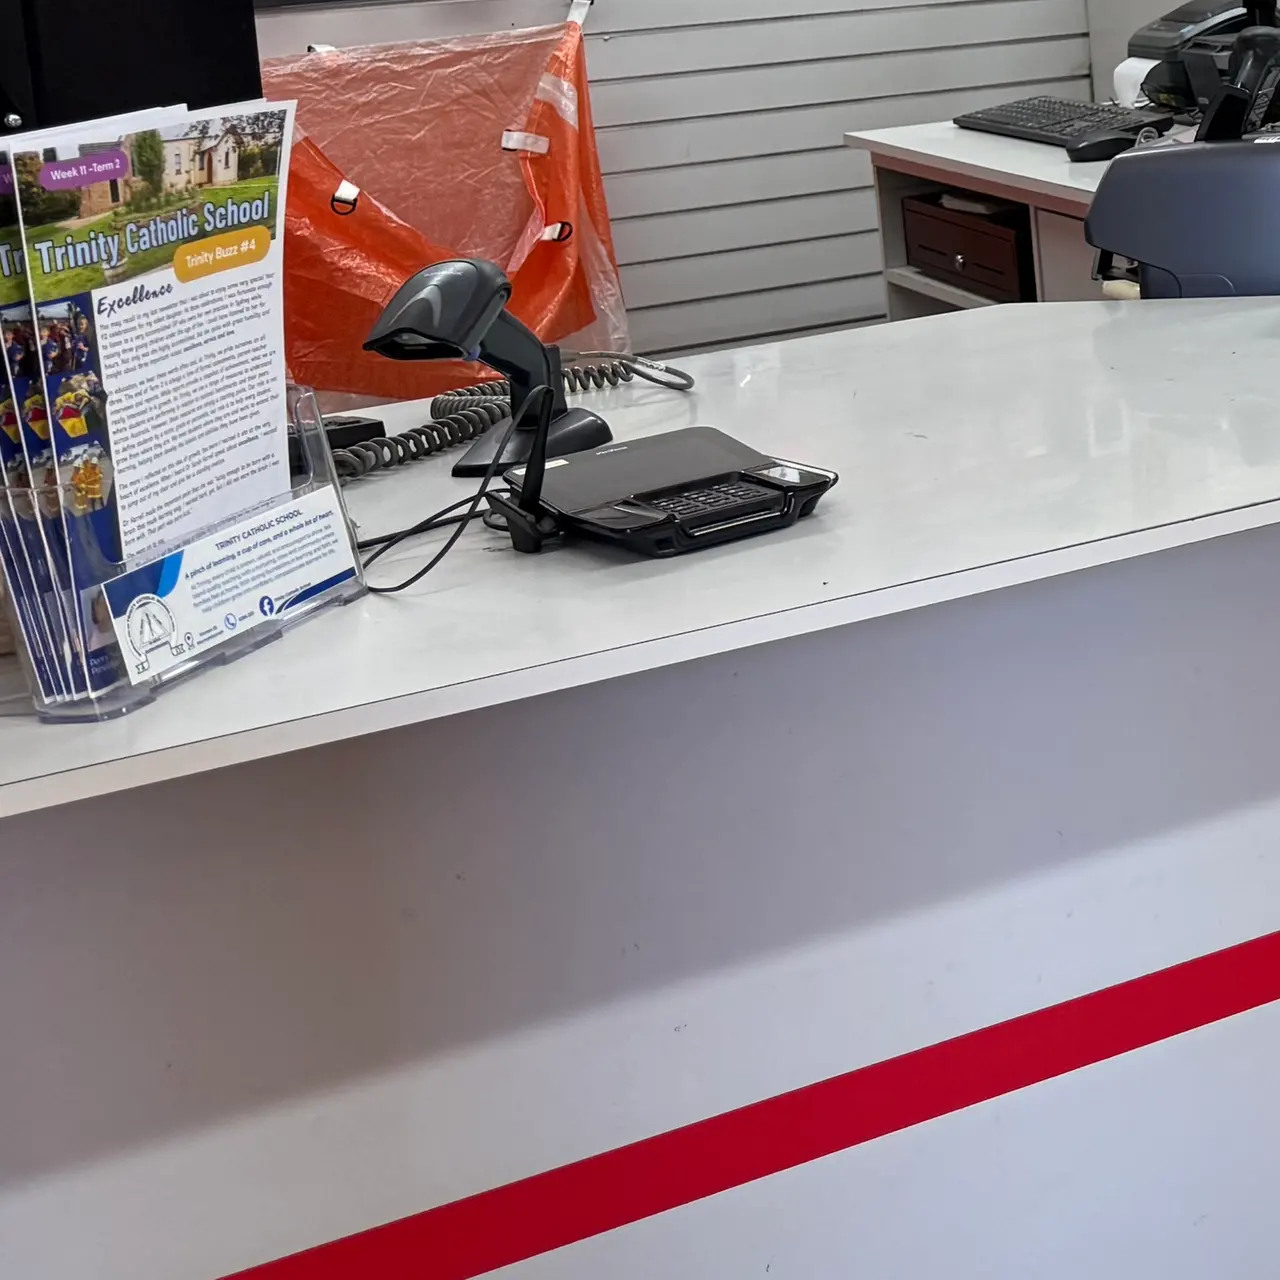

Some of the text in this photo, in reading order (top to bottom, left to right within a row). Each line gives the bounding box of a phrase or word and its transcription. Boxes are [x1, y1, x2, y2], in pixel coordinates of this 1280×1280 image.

[50, 166, 78, 181] Week
[79, 164, 87, 175] 11
[113, 159, 121, 170] 2
[35, 231, 121, 274] Trinity
[125, 207, 199, 254] Catholic
[203, 191, 270, 232] School
[185, 238, 256, 268] Trinity Buzz #4
[97, 283, 173, 318] Excellence
[215, 534, 242, 550] TRINITY
[242, 521, 275, 540] CATHOLIC
